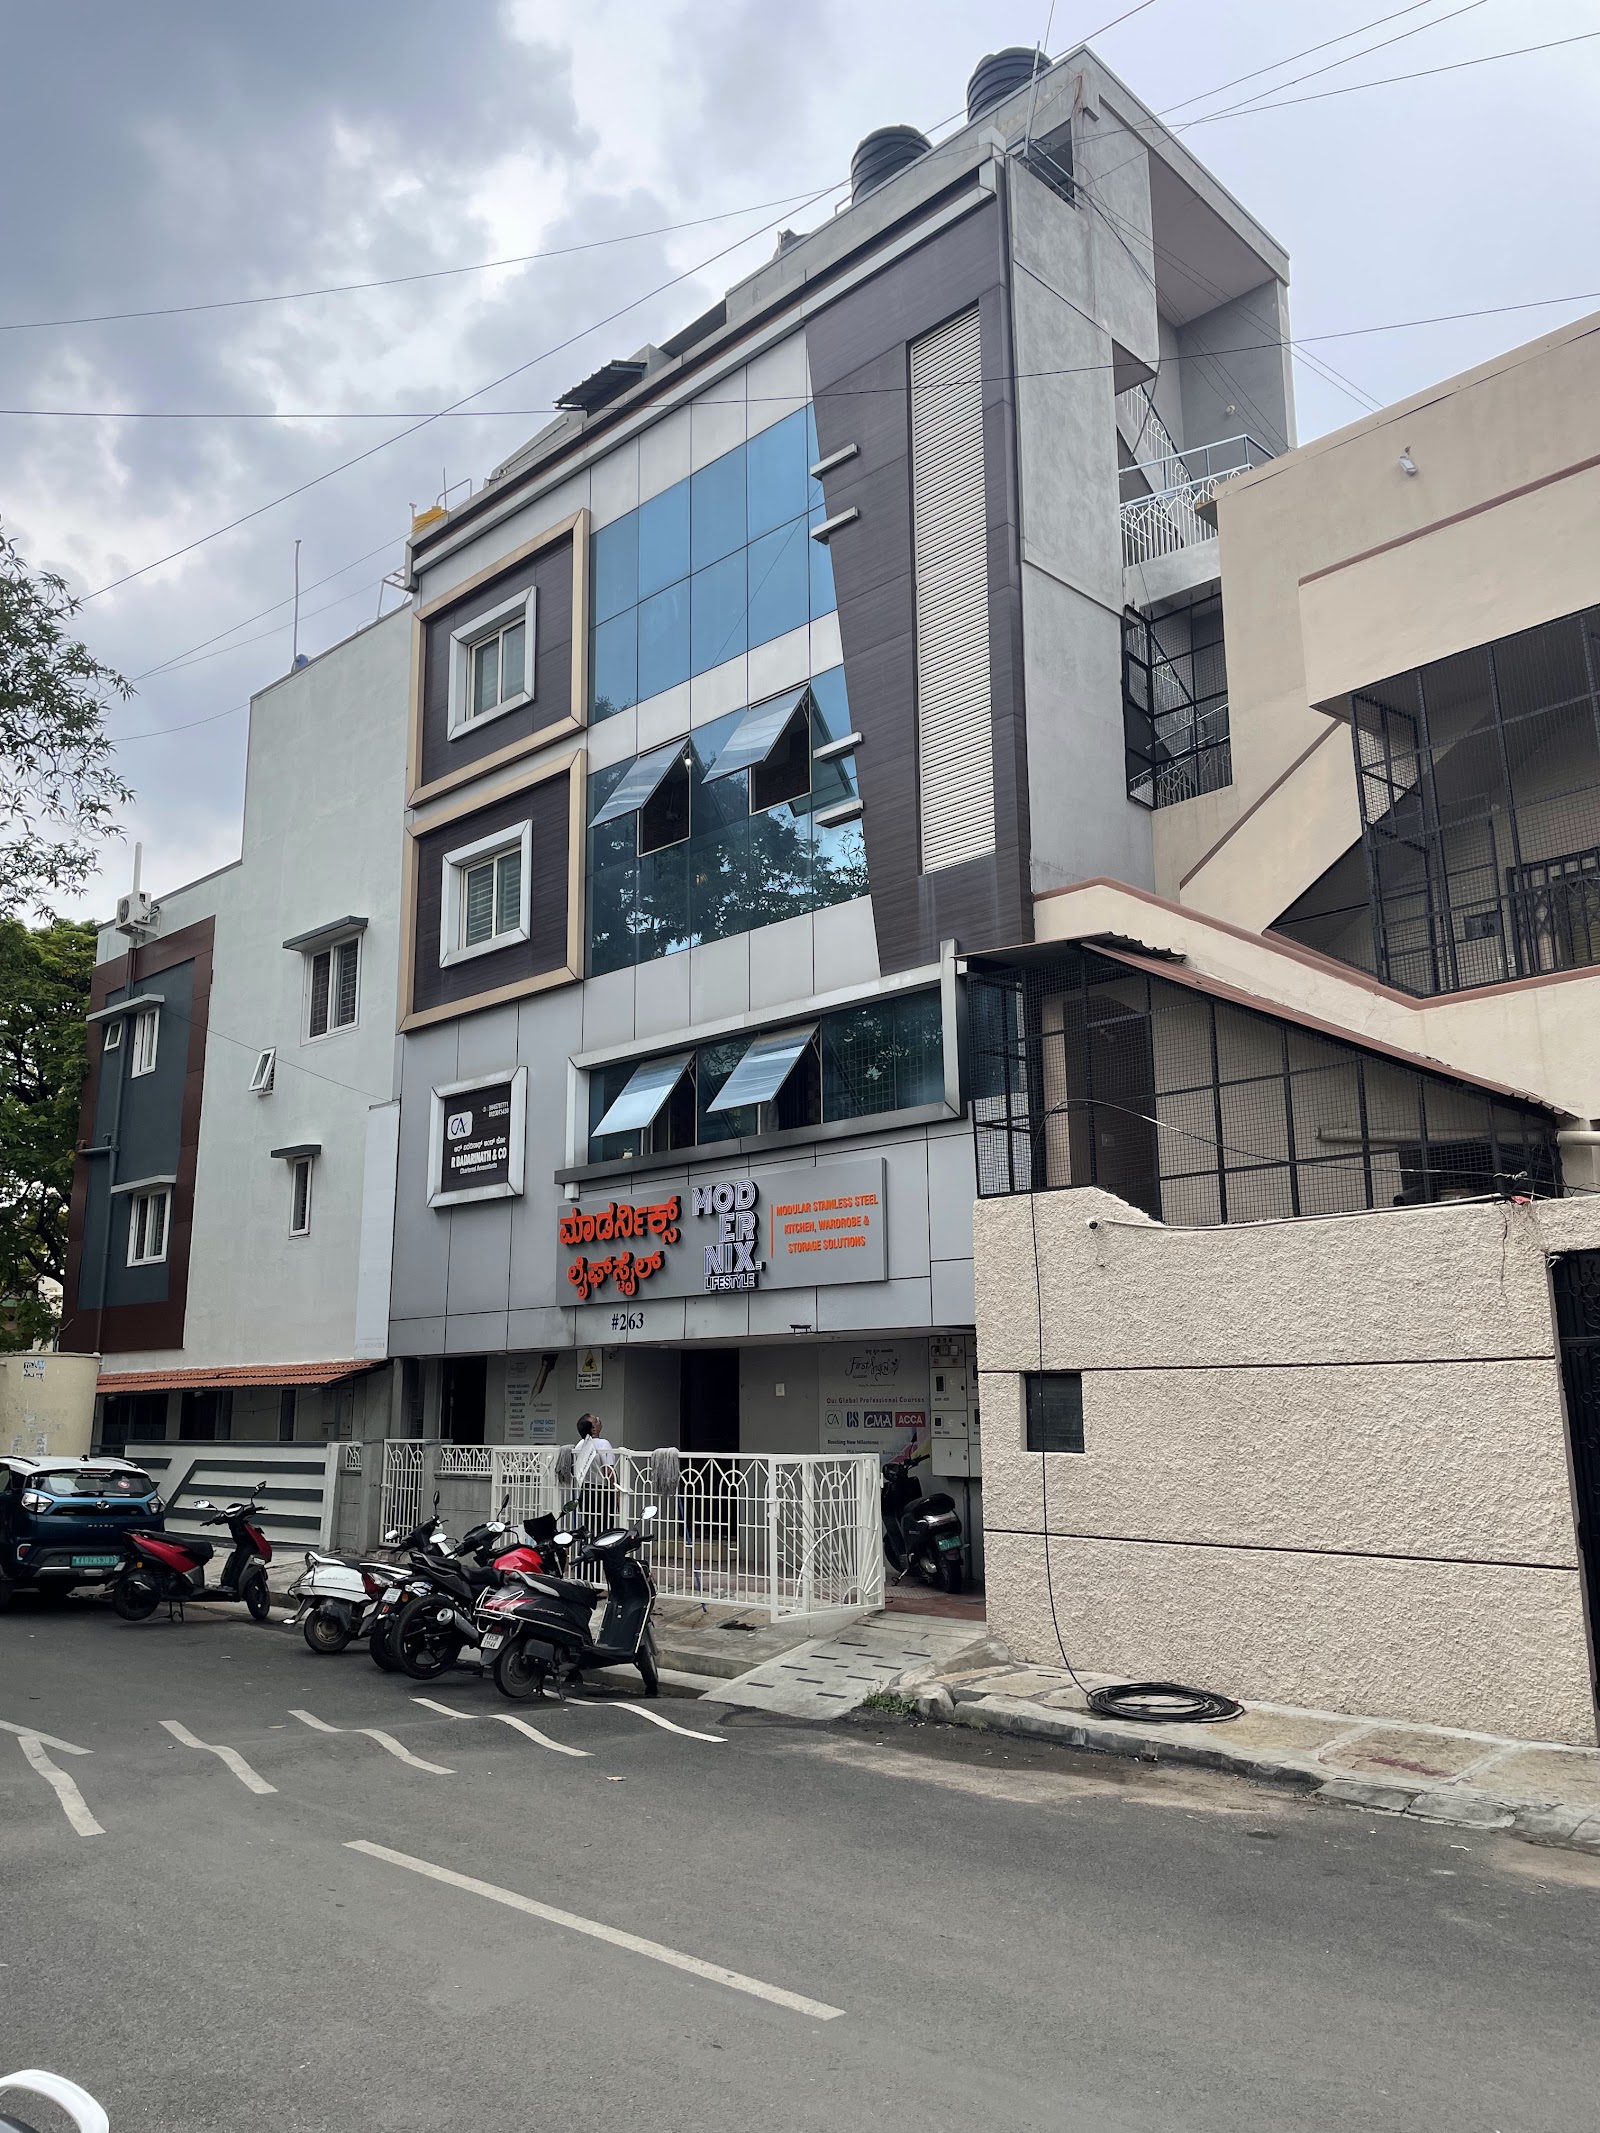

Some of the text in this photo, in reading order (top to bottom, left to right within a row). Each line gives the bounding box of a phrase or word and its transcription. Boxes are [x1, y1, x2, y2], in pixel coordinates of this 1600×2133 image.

[451, 1147, 507, 1168] R BADARINATH & CO
[460, 1165, 476, 1174] Chartered
[692, 1180, 757, 1216] MOD
[776, 1194, 878, 1216] MODULAR STAINLESS STEEL
[719, 1211, 757, 1242] ER
[784, 1215, 869, 1234] KITCHEN, WARDROBE &
[788, 1235, 866, 1254] STORAGE SOLUTIONS
[704, 1273, 756, 1290] LIFESTYLE
[611, 1312, 644, 1331] #263
[865, 1414, 892, 1427] CMA
[898, 1415, 923, 1424] ACCA
